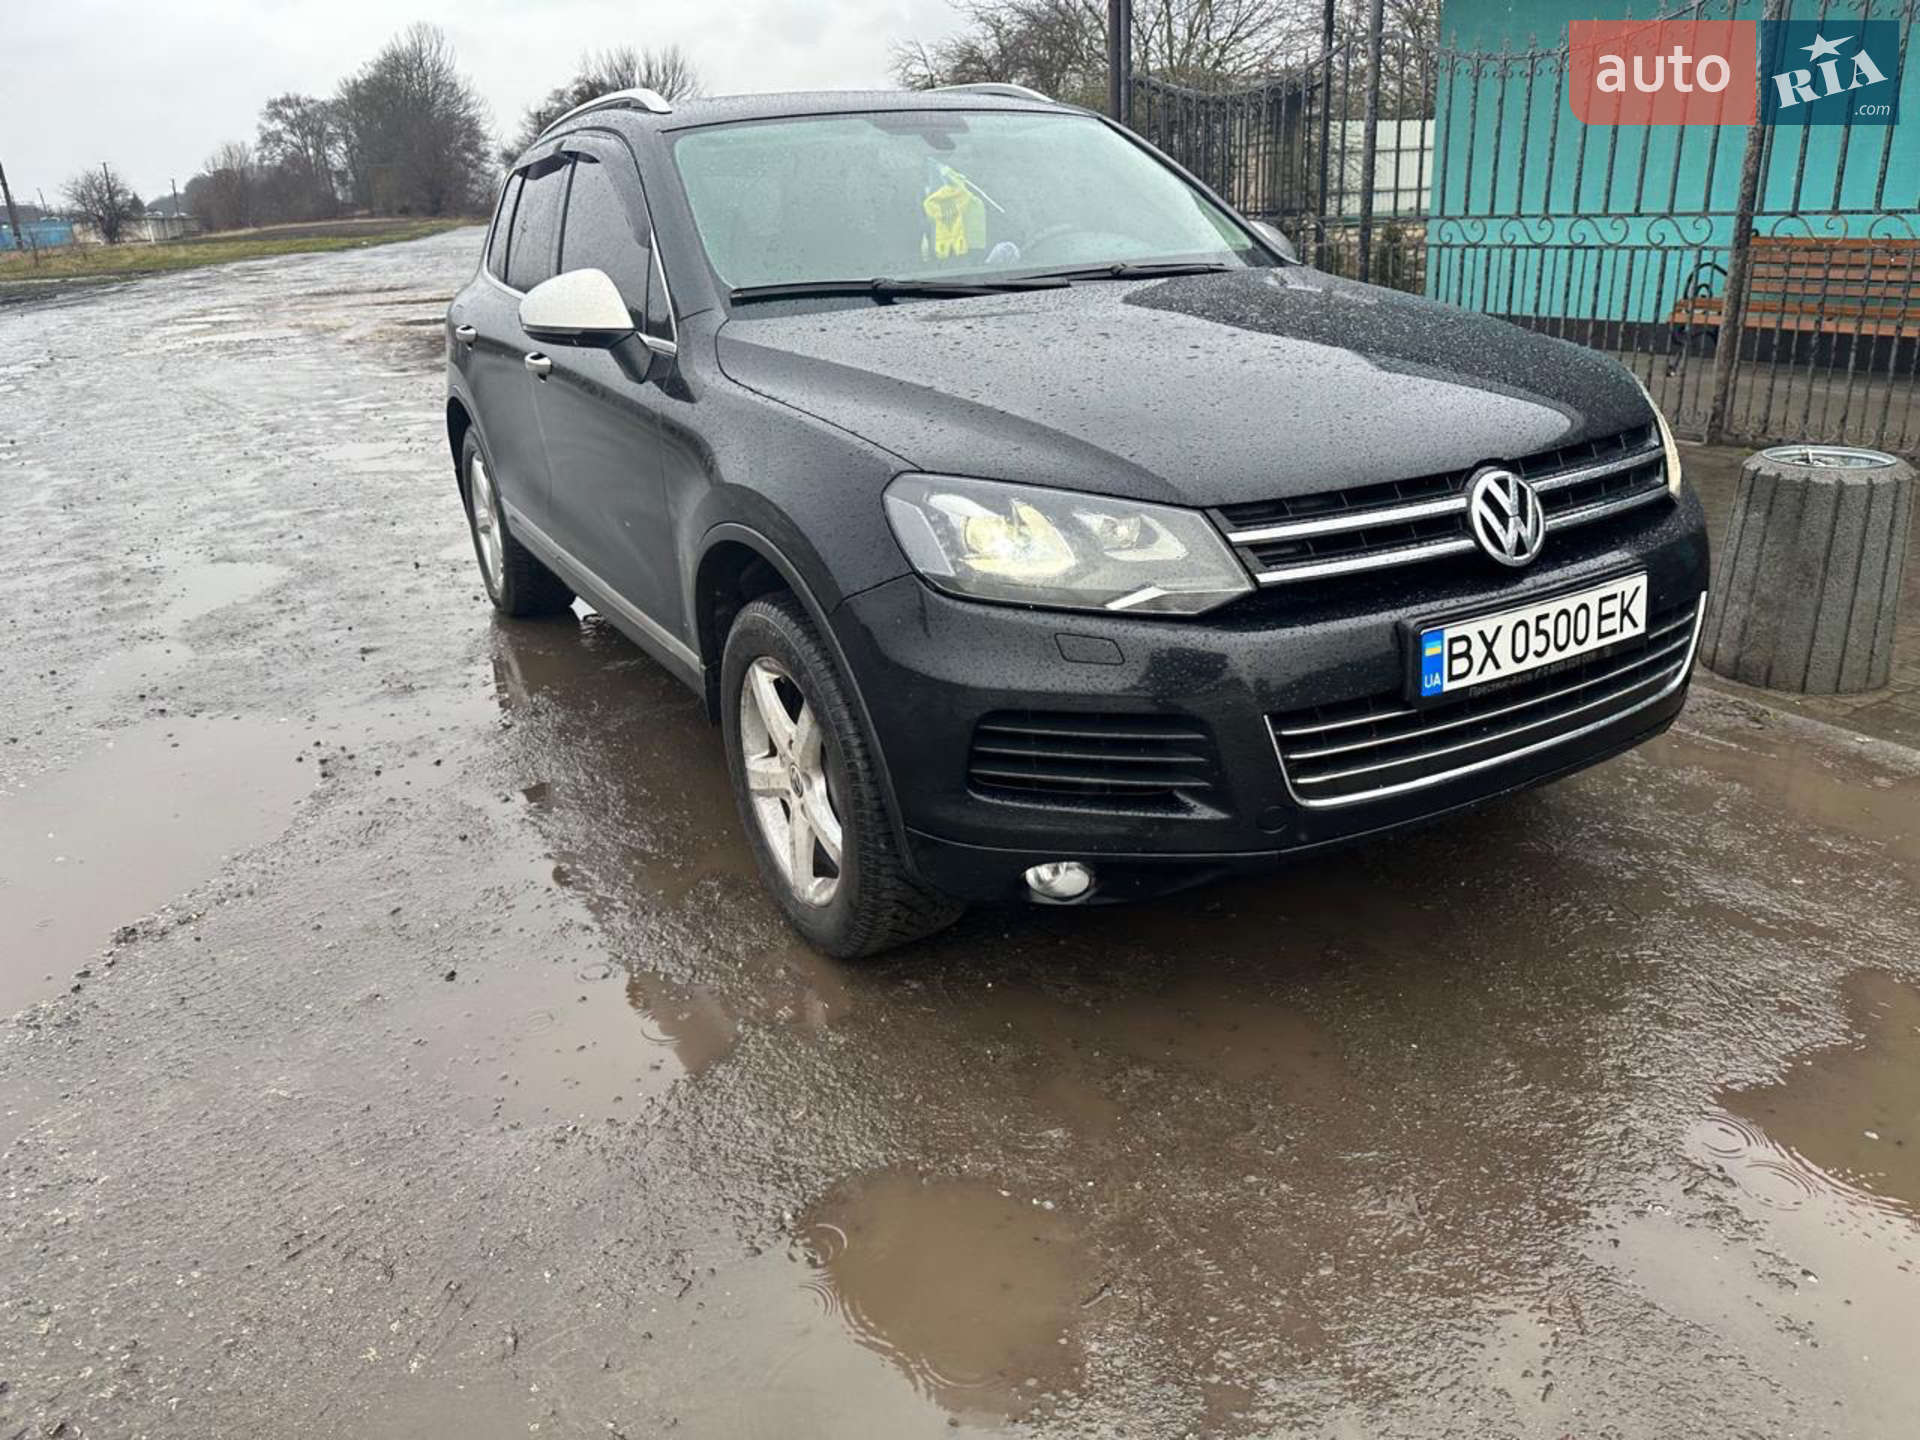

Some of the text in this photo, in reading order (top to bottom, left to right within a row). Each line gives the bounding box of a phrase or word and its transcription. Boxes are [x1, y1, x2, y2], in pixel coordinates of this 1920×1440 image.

[1447, 624, 1503, 684] BX
[1511, 602, 1591, 664] 0500
[1596, 585, 1641, 641] EK
[1424, 673, 1441, 689] UA
